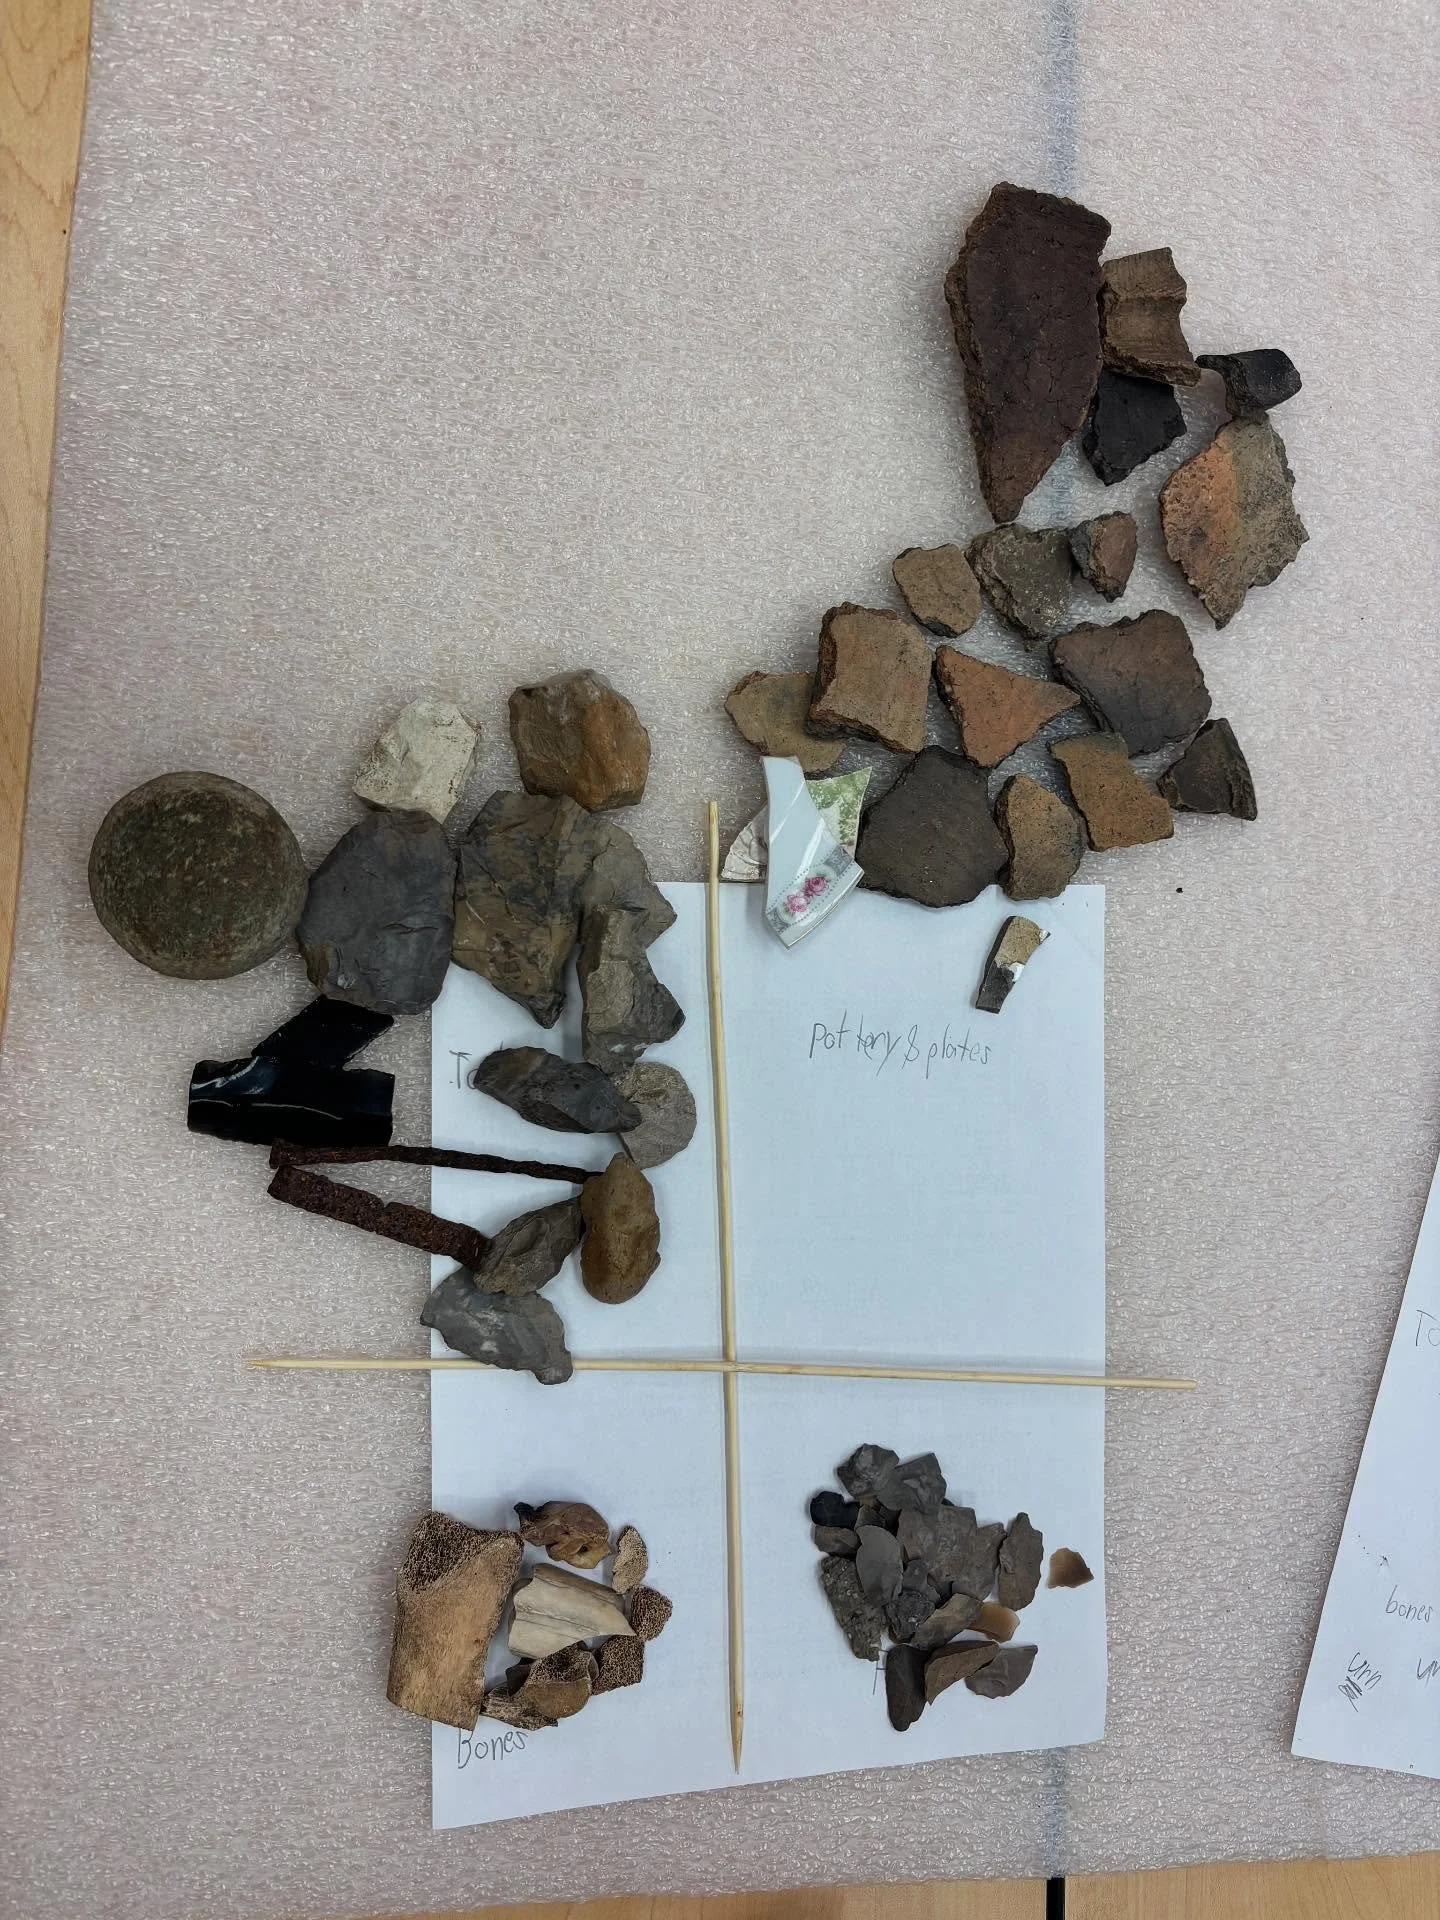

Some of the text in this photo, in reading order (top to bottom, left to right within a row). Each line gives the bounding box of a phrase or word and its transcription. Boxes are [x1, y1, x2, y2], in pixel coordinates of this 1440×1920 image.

[926, 1023, 992, 1079] plates
[1385, 1584, 1433, 1623] bones
[457, 1728, 529, 1769] Bones
